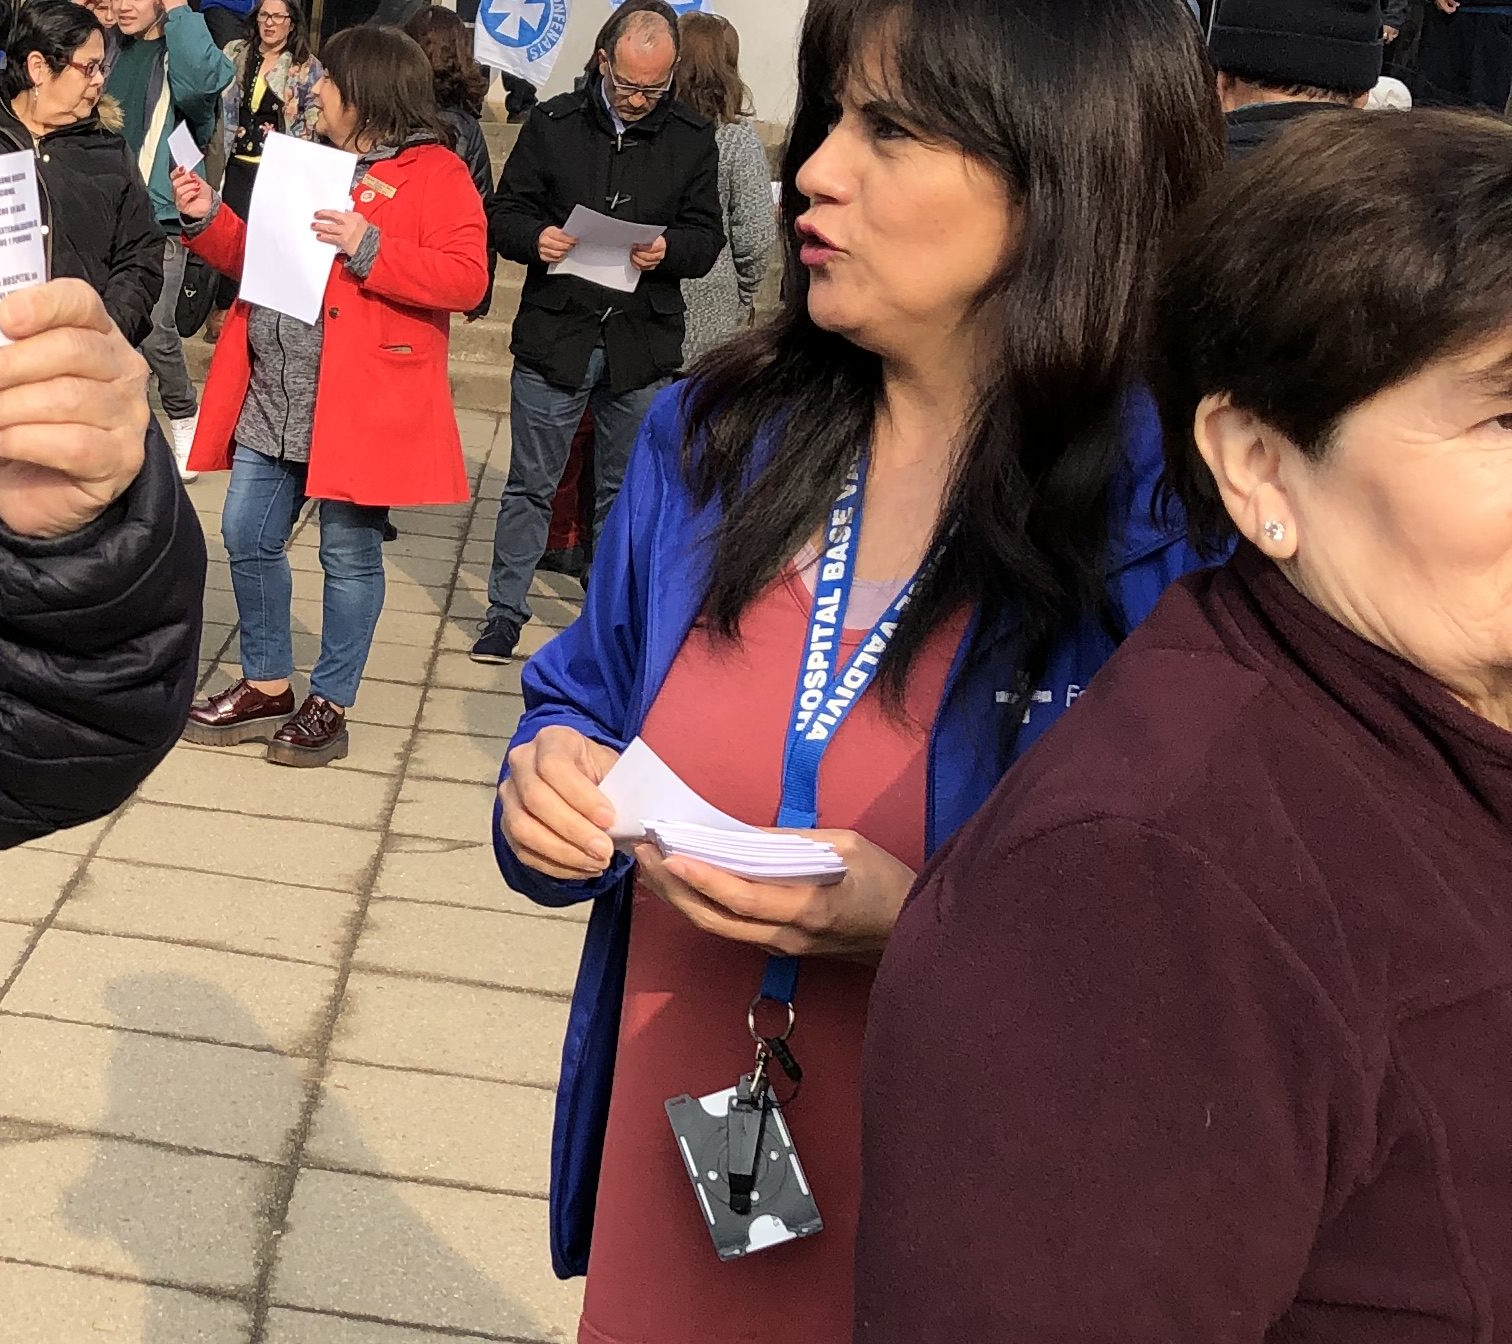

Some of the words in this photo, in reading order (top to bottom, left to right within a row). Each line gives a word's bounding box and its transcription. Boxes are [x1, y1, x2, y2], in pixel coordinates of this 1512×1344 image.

[796, 587, 841, 731] HOSPITAL
[823, 507, 853, 583] BASE
[805, 621, 898, 741] VALDIVIA
